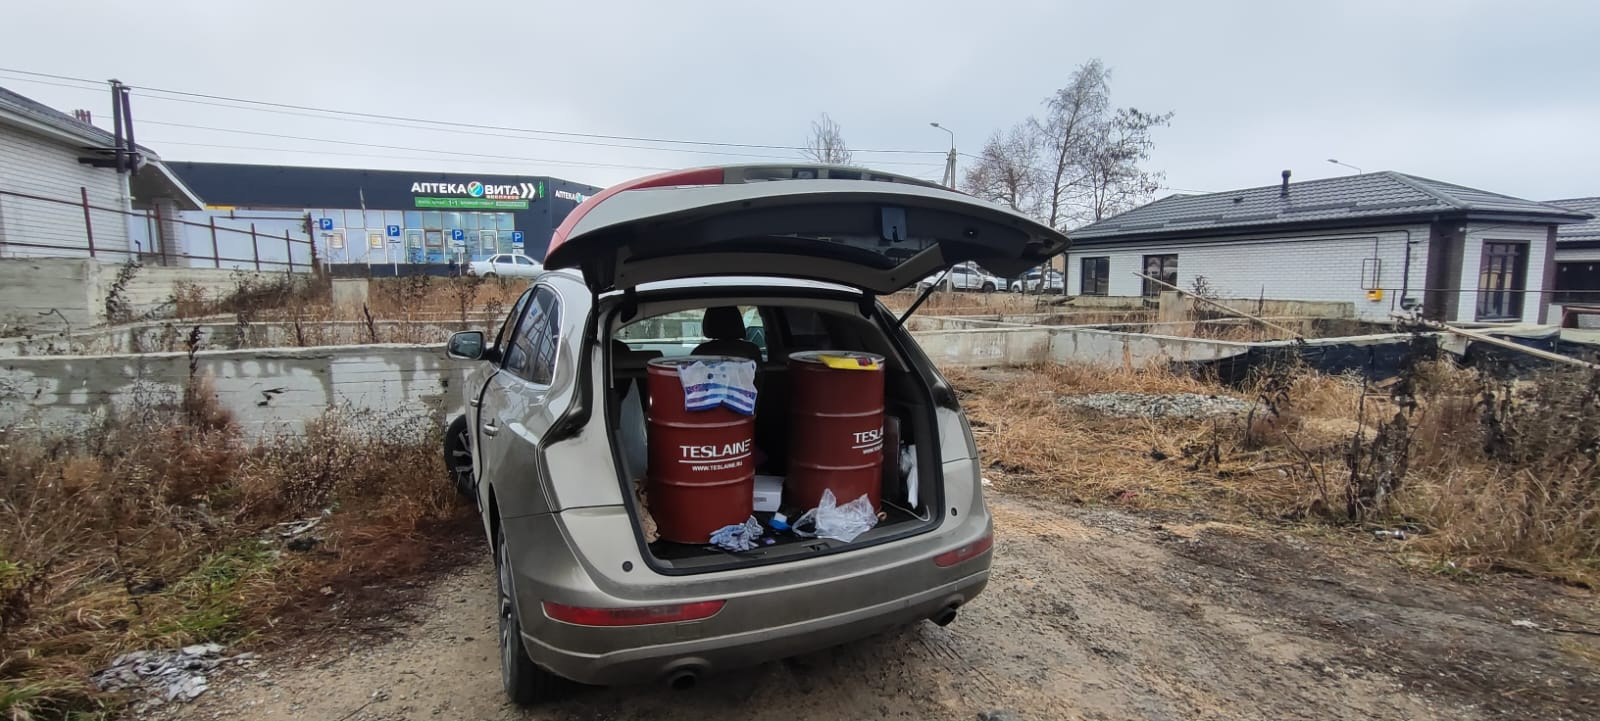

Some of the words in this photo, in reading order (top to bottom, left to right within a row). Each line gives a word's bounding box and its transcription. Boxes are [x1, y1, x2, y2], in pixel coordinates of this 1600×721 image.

[411, 182, 467, 194] АПТЕКА
[484, 184, 520, 196] ВИТА
[679, 438, 752, 459] TESLAINE
